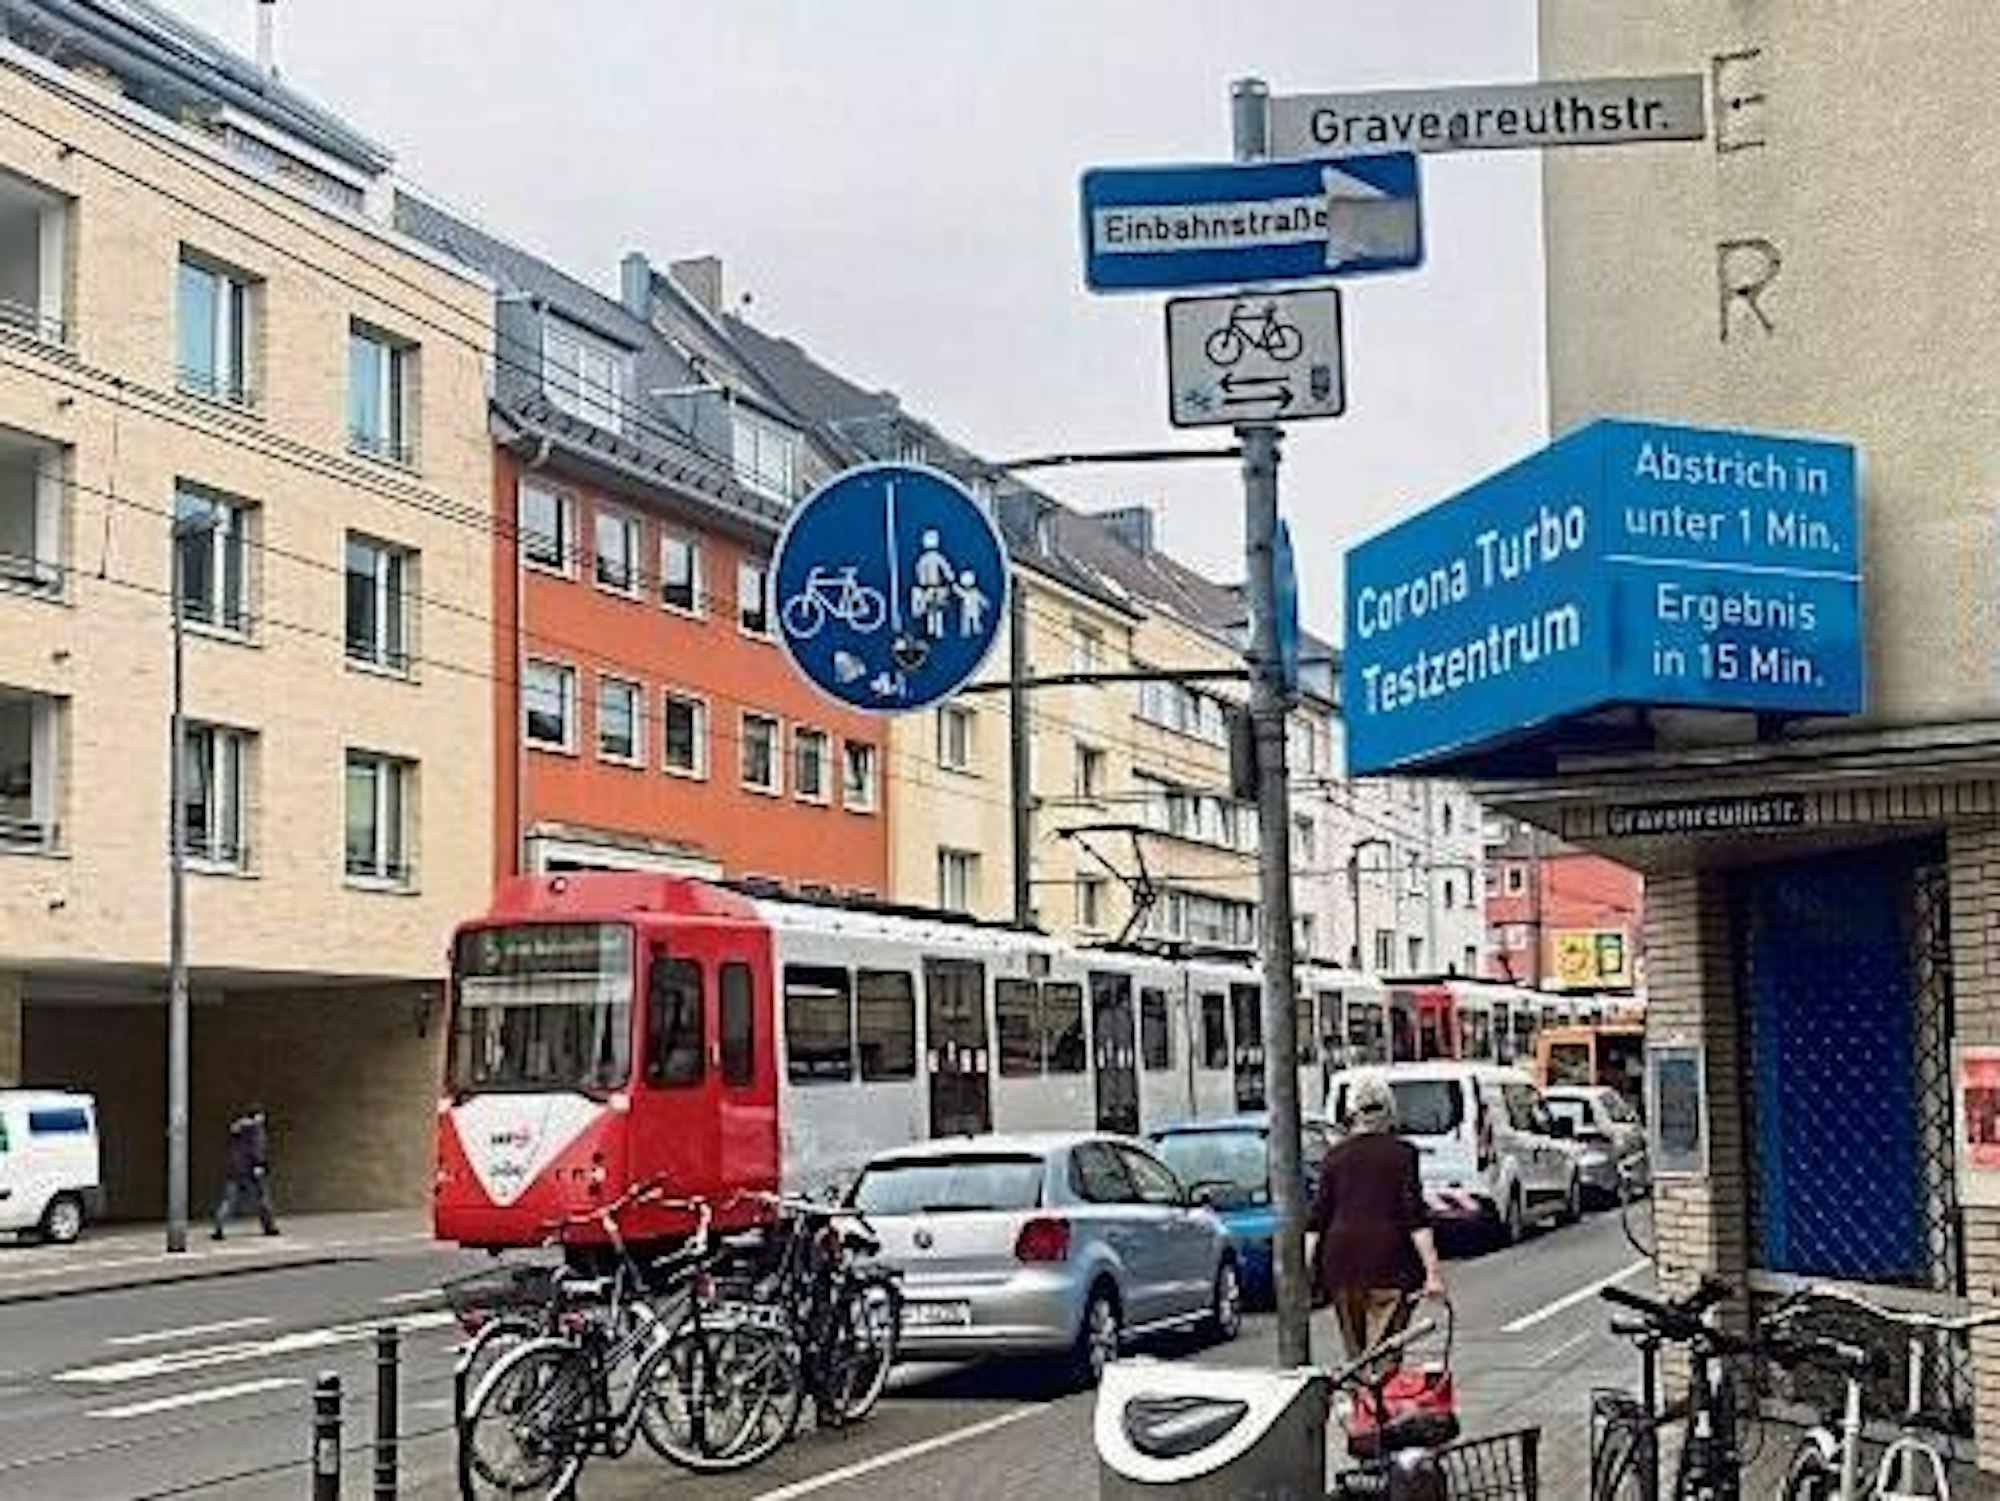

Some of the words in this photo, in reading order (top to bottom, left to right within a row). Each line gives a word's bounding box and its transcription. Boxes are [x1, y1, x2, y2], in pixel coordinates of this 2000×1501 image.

[1310, 96, 1670, 144] Gravenreuthstr.
[1105, 206, 1329, 244] Einbahnstraße
[1635, 441, 1788, 493] Abstrich
[1797, 457, 1829, 497] in
[1624, 505, 1726, 542] unter
[1738, 508, 1752, 547] 1
[1766, 509, 1841, 554] Min.
[1356, 557, 1469, 640] Corona
[1475, 504, 1585, 587] Turbo
[1656, 582, 1818, 633] Ergebnis
[1361, 603, 1581, 716] Testzentrum
[1652, 640, 1686, 677] in
[1700, 642, 1739, 682] 15
[1750, 645, 1825, 689] Min.
